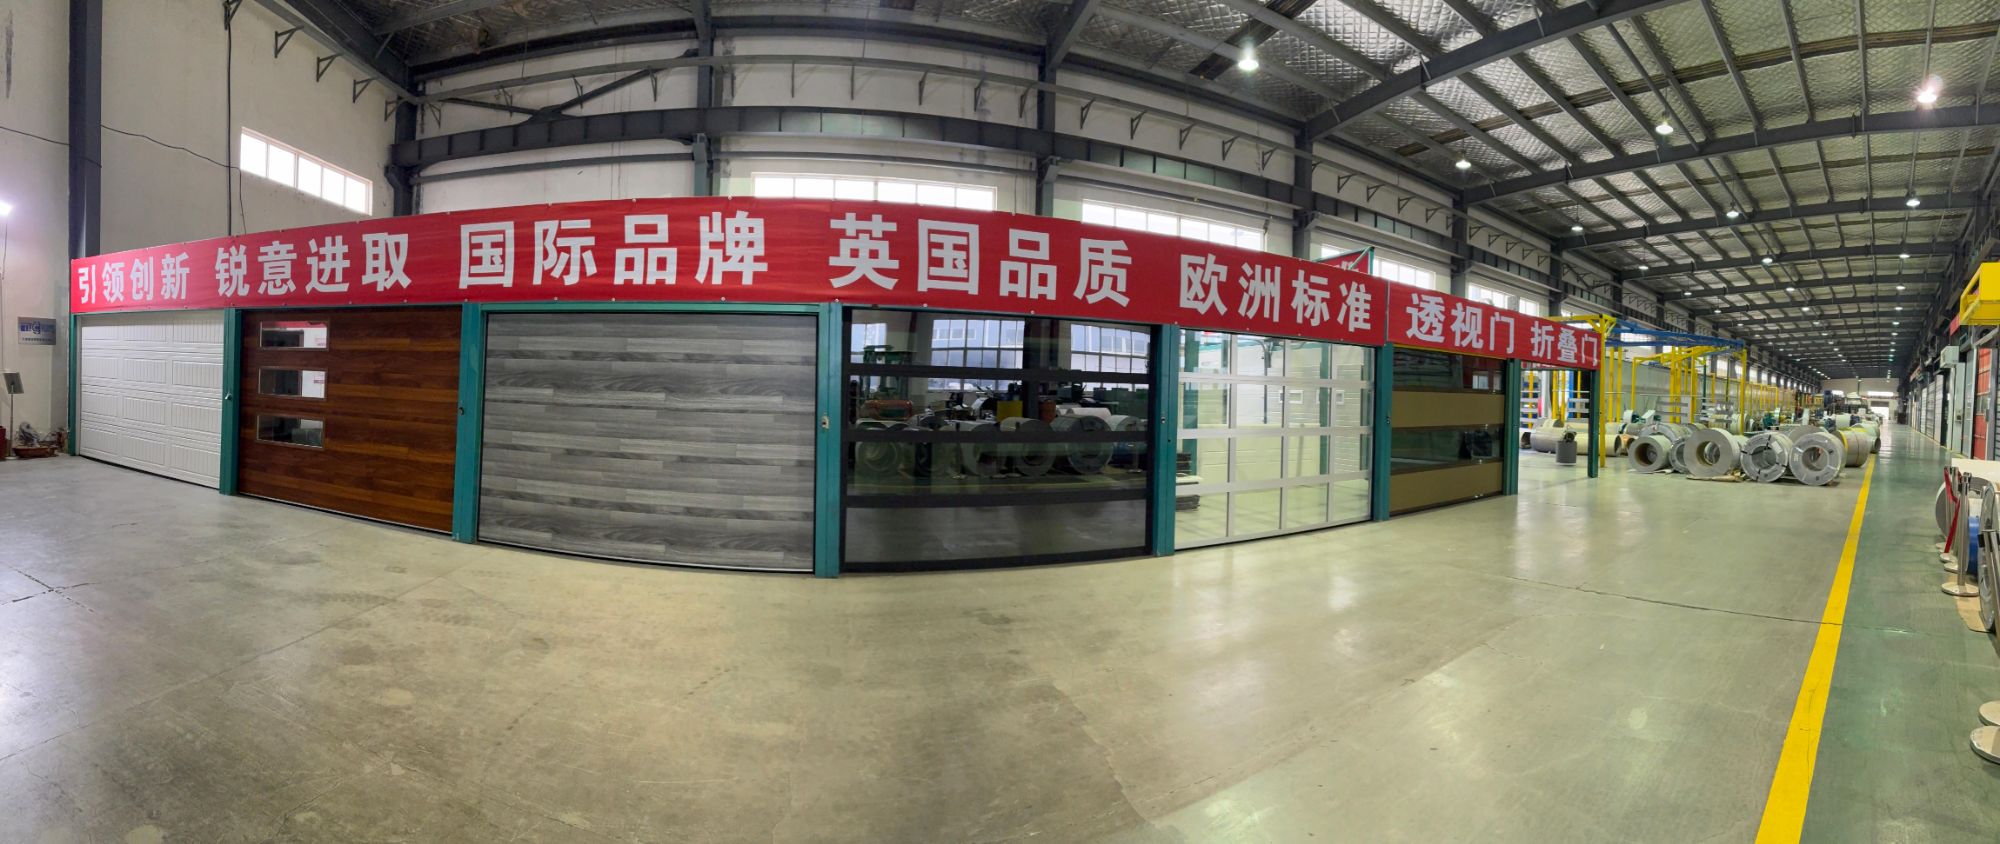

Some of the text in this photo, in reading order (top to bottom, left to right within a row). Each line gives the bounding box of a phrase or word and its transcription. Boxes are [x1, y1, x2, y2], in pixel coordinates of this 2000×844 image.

[78, 211, 1372, 332] 引领创新 锐意进取 国际品牌 英国品质 欧洲标准
[1406, 293, 1598, 367] 透视门 折叠门
